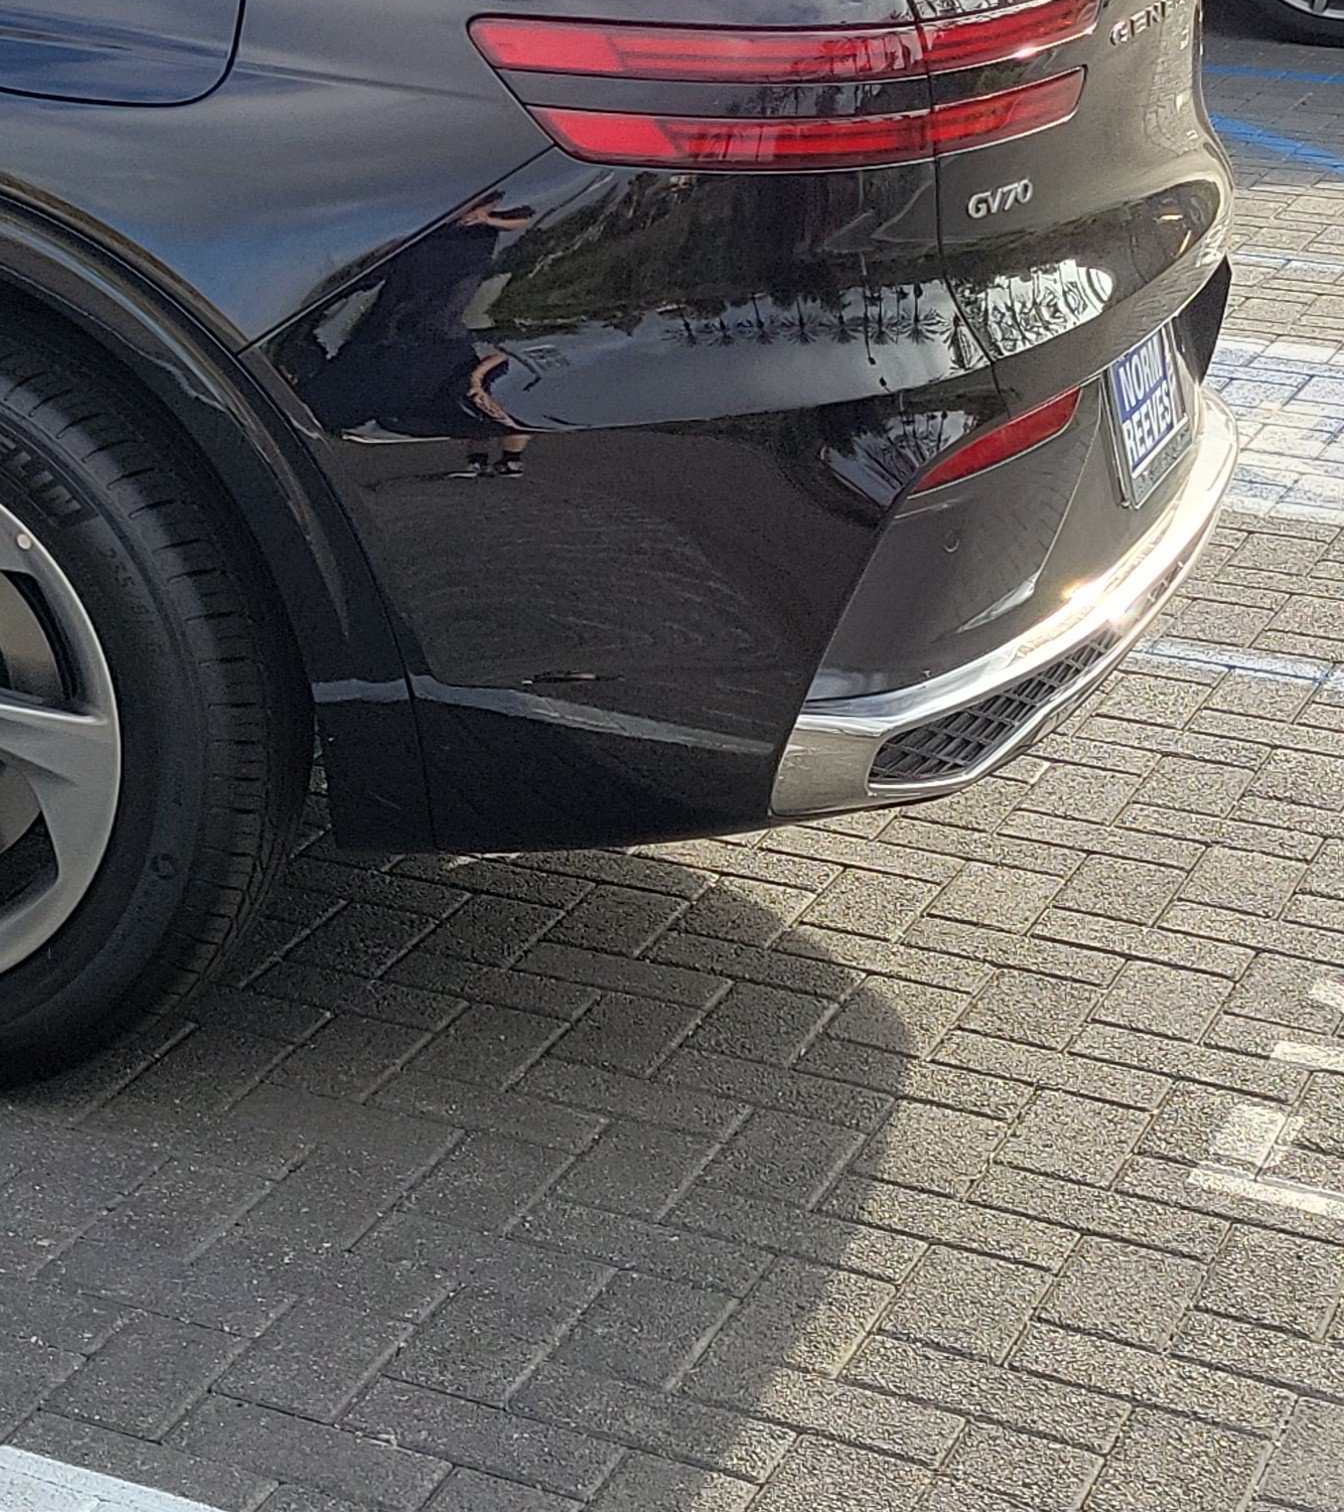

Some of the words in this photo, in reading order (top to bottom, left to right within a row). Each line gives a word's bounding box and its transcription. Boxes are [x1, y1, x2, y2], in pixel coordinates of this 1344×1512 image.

[967, 179, 1033, 219] GV70
[1118, 334, 1163, 412] NORM
[1122, 380, 1173, 463] REEVES
